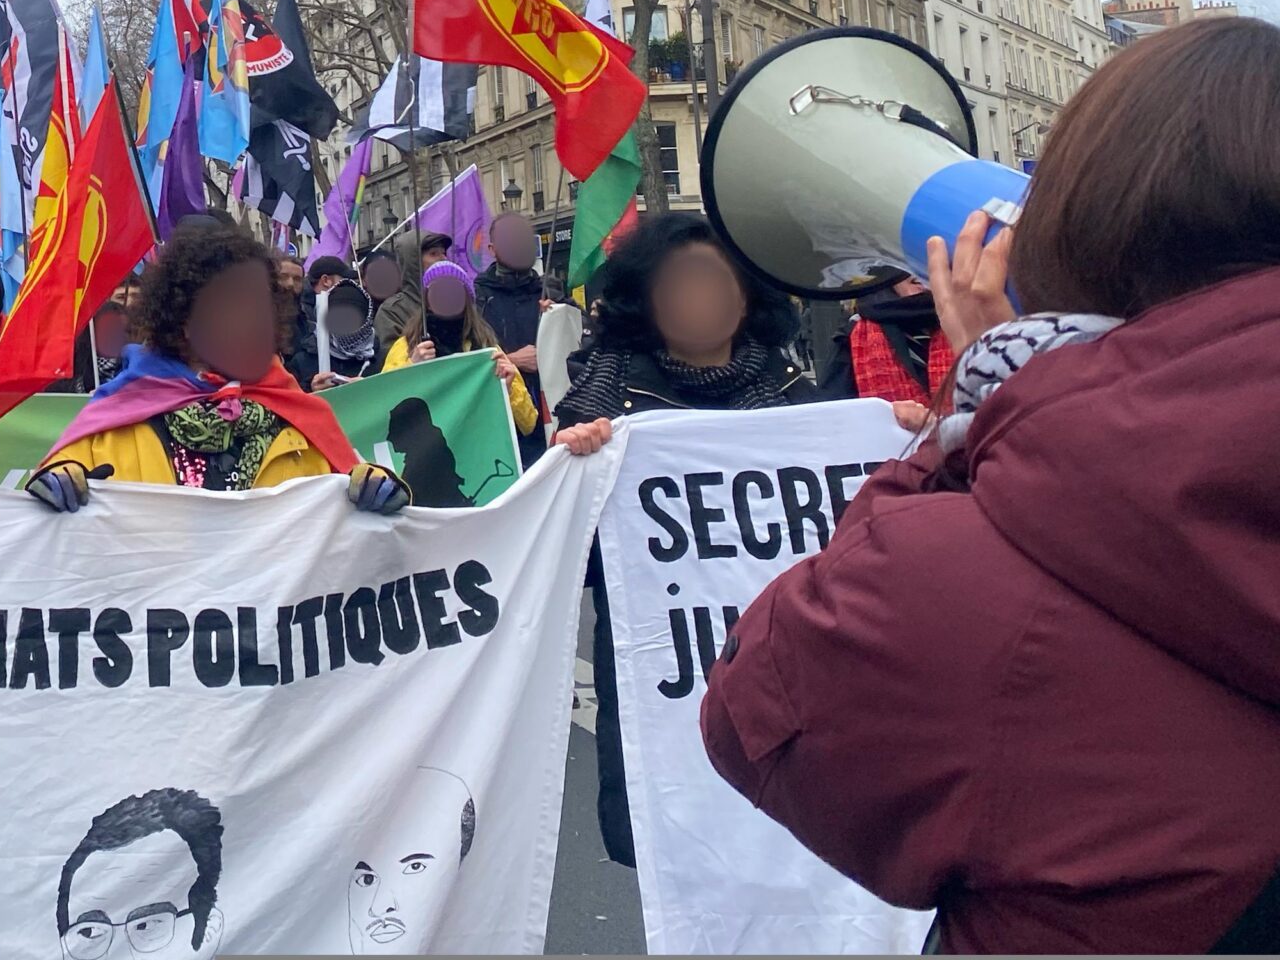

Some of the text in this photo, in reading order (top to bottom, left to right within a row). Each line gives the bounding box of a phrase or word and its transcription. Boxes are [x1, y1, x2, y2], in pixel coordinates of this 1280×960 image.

[247, 53, 290, 74] MUNISTE
[638, 461, 888, 562] SECRE
[147, 559, 500, 688] POLITIQUES
